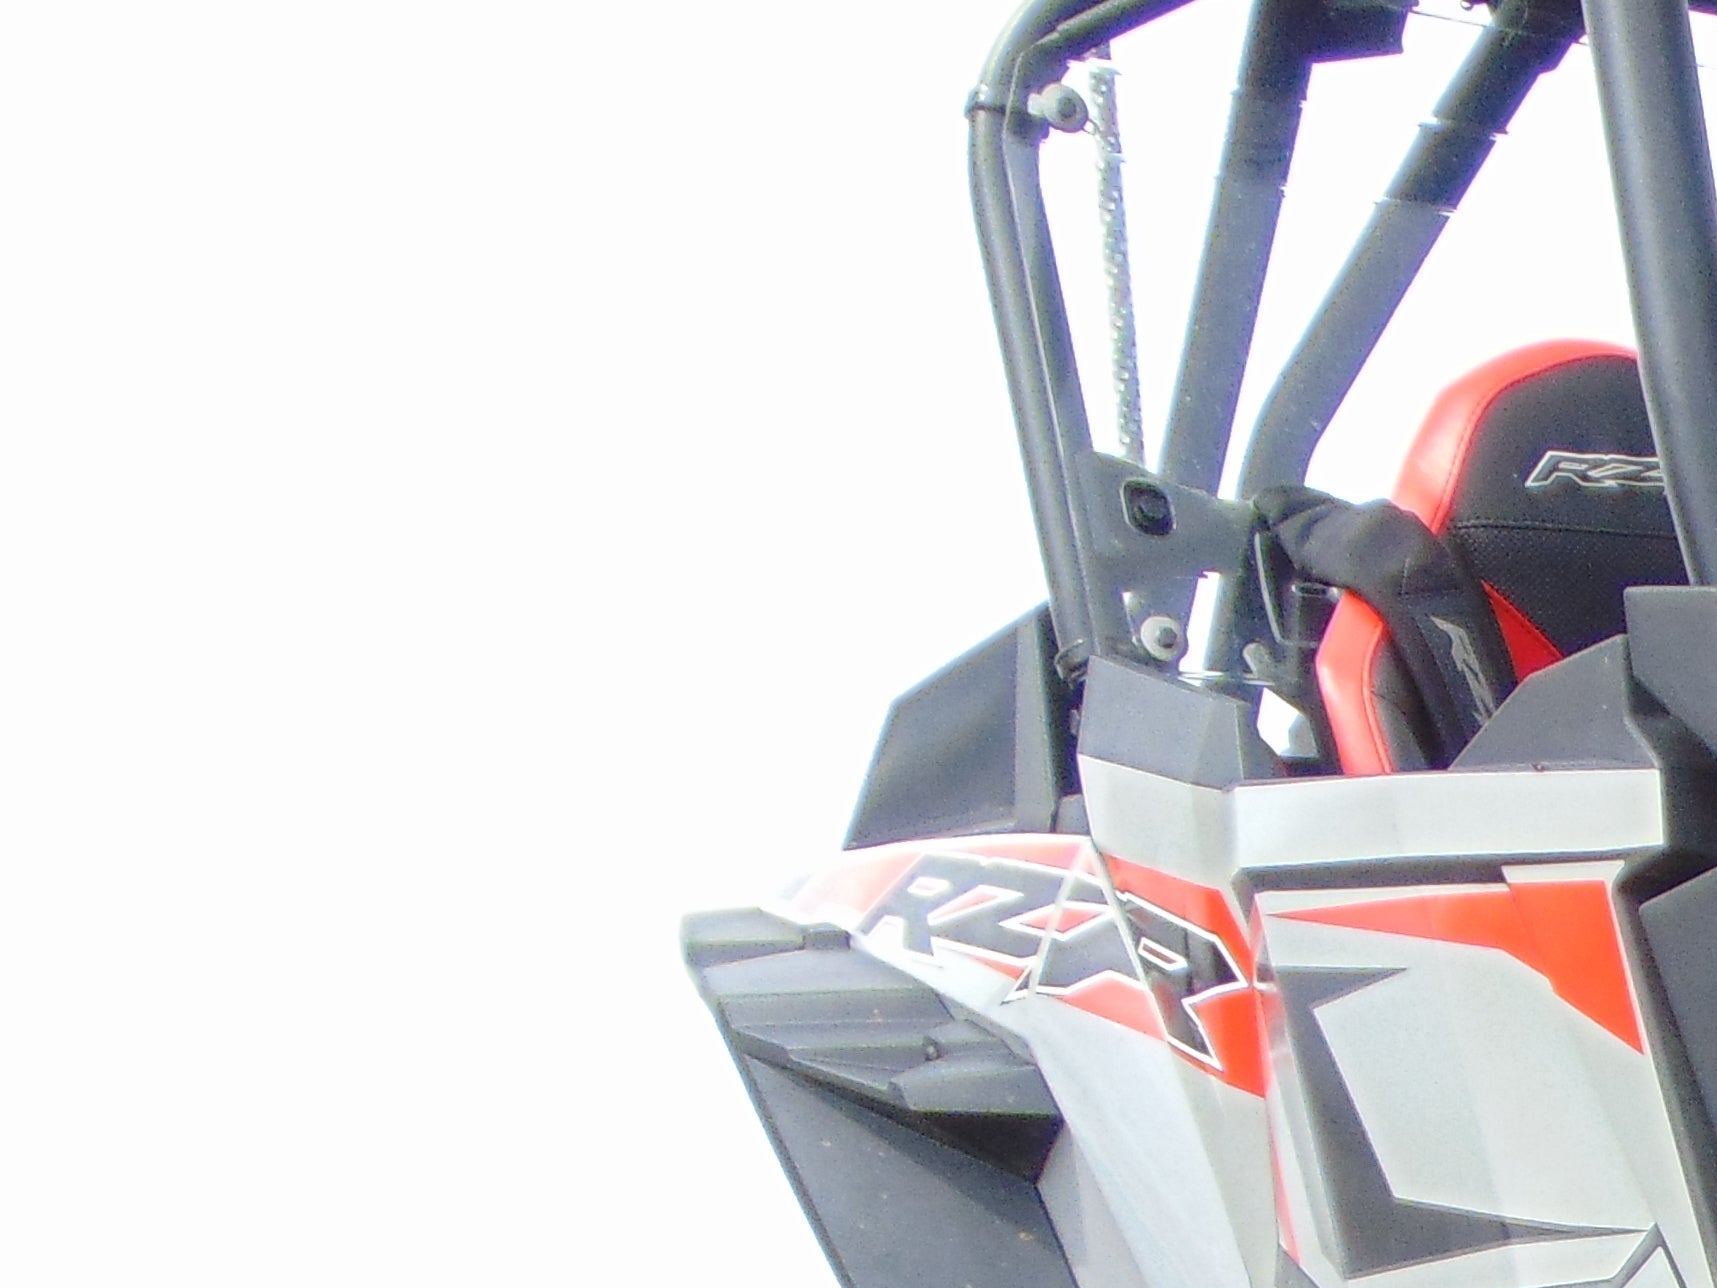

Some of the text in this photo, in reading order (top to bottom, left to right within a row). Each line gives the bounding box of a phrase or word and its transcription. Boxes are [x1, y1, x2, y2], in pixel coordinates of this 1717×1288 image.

[1524, 450, 1666, 488] RZ
[1429, 614, 1497, 723] RZ
[853, 852, 1250, 1073] RZR
